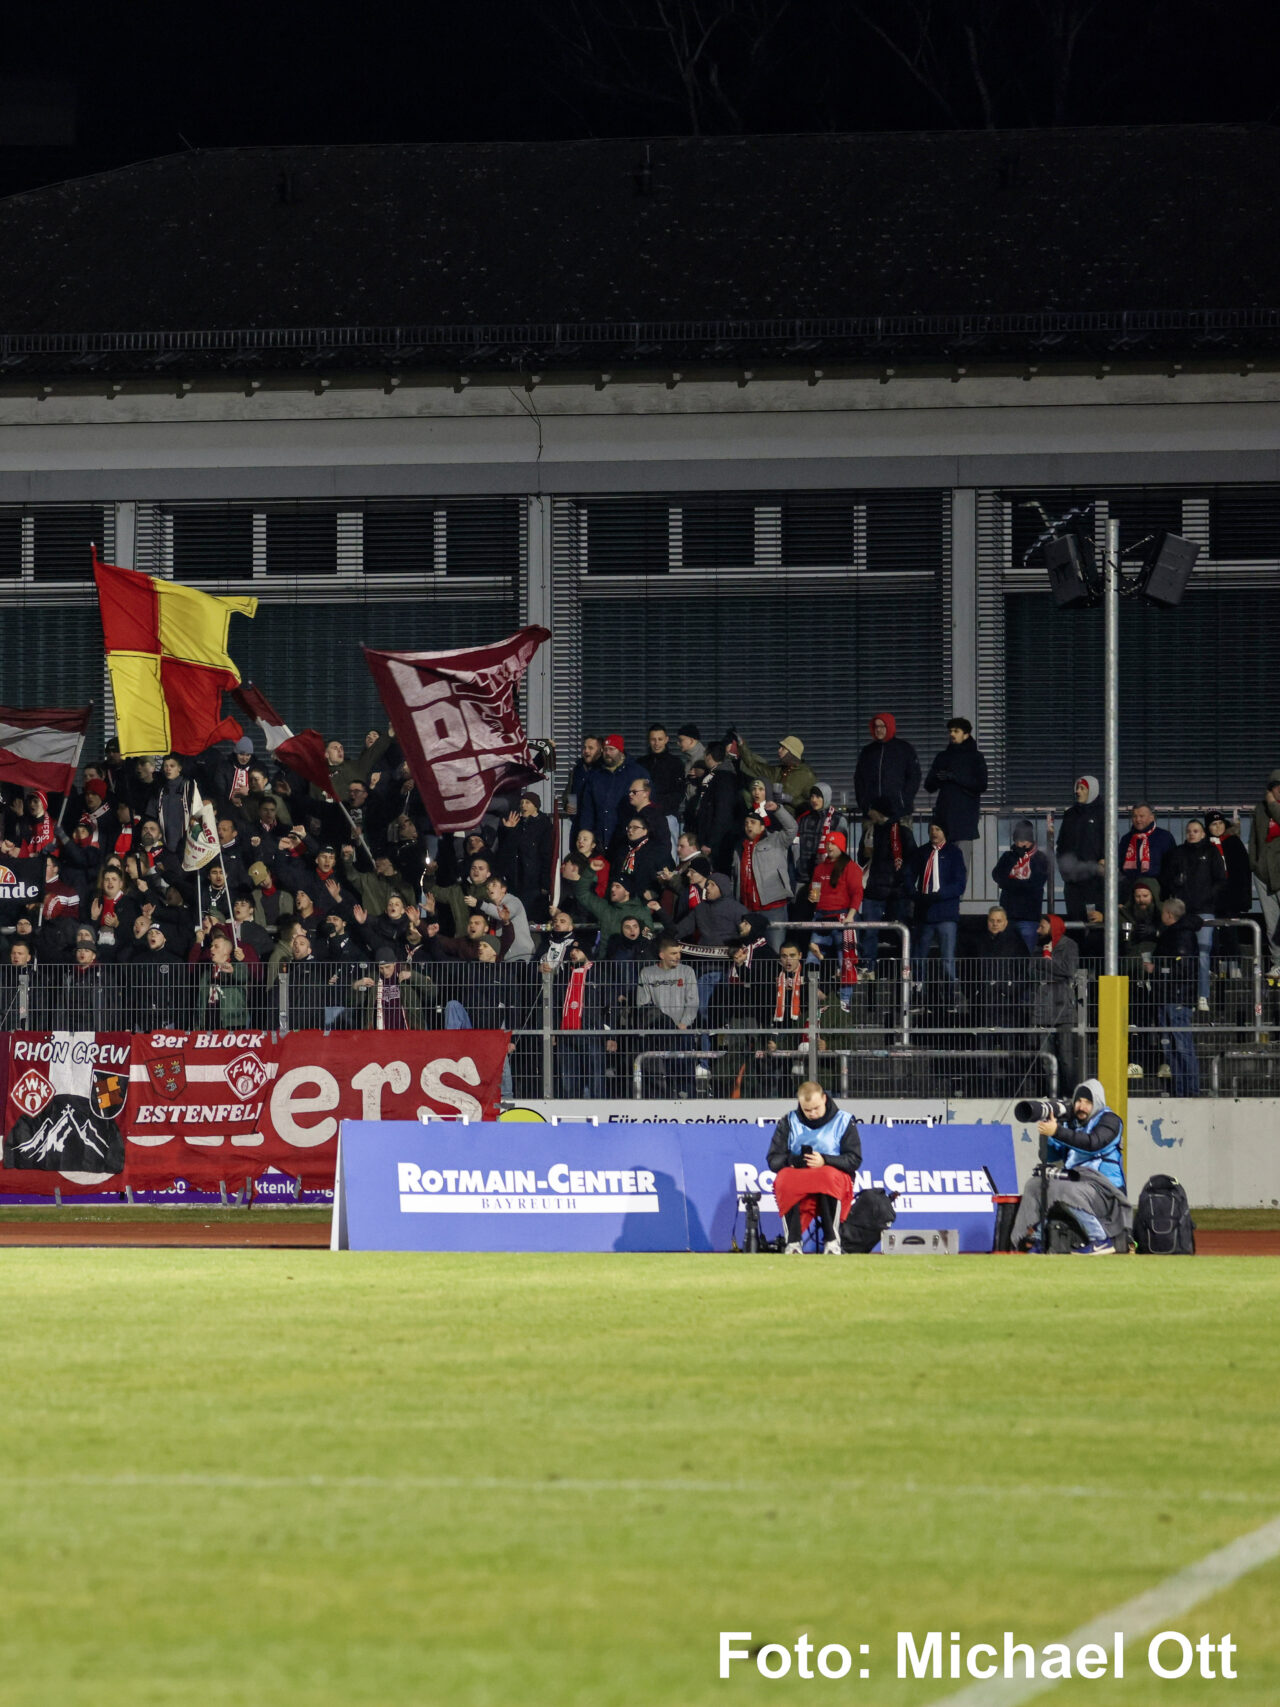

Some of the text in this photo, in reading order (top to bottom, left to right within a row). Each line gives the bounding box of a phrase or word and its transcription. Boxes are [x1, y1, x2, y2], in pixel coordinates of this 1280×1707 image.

[151, 1033, 264, 1048] 3er BLOCK
[14, 1035, 131, 1065] RHÖN CREW
[482, 1198, 578, 1210] BAYREUTH
